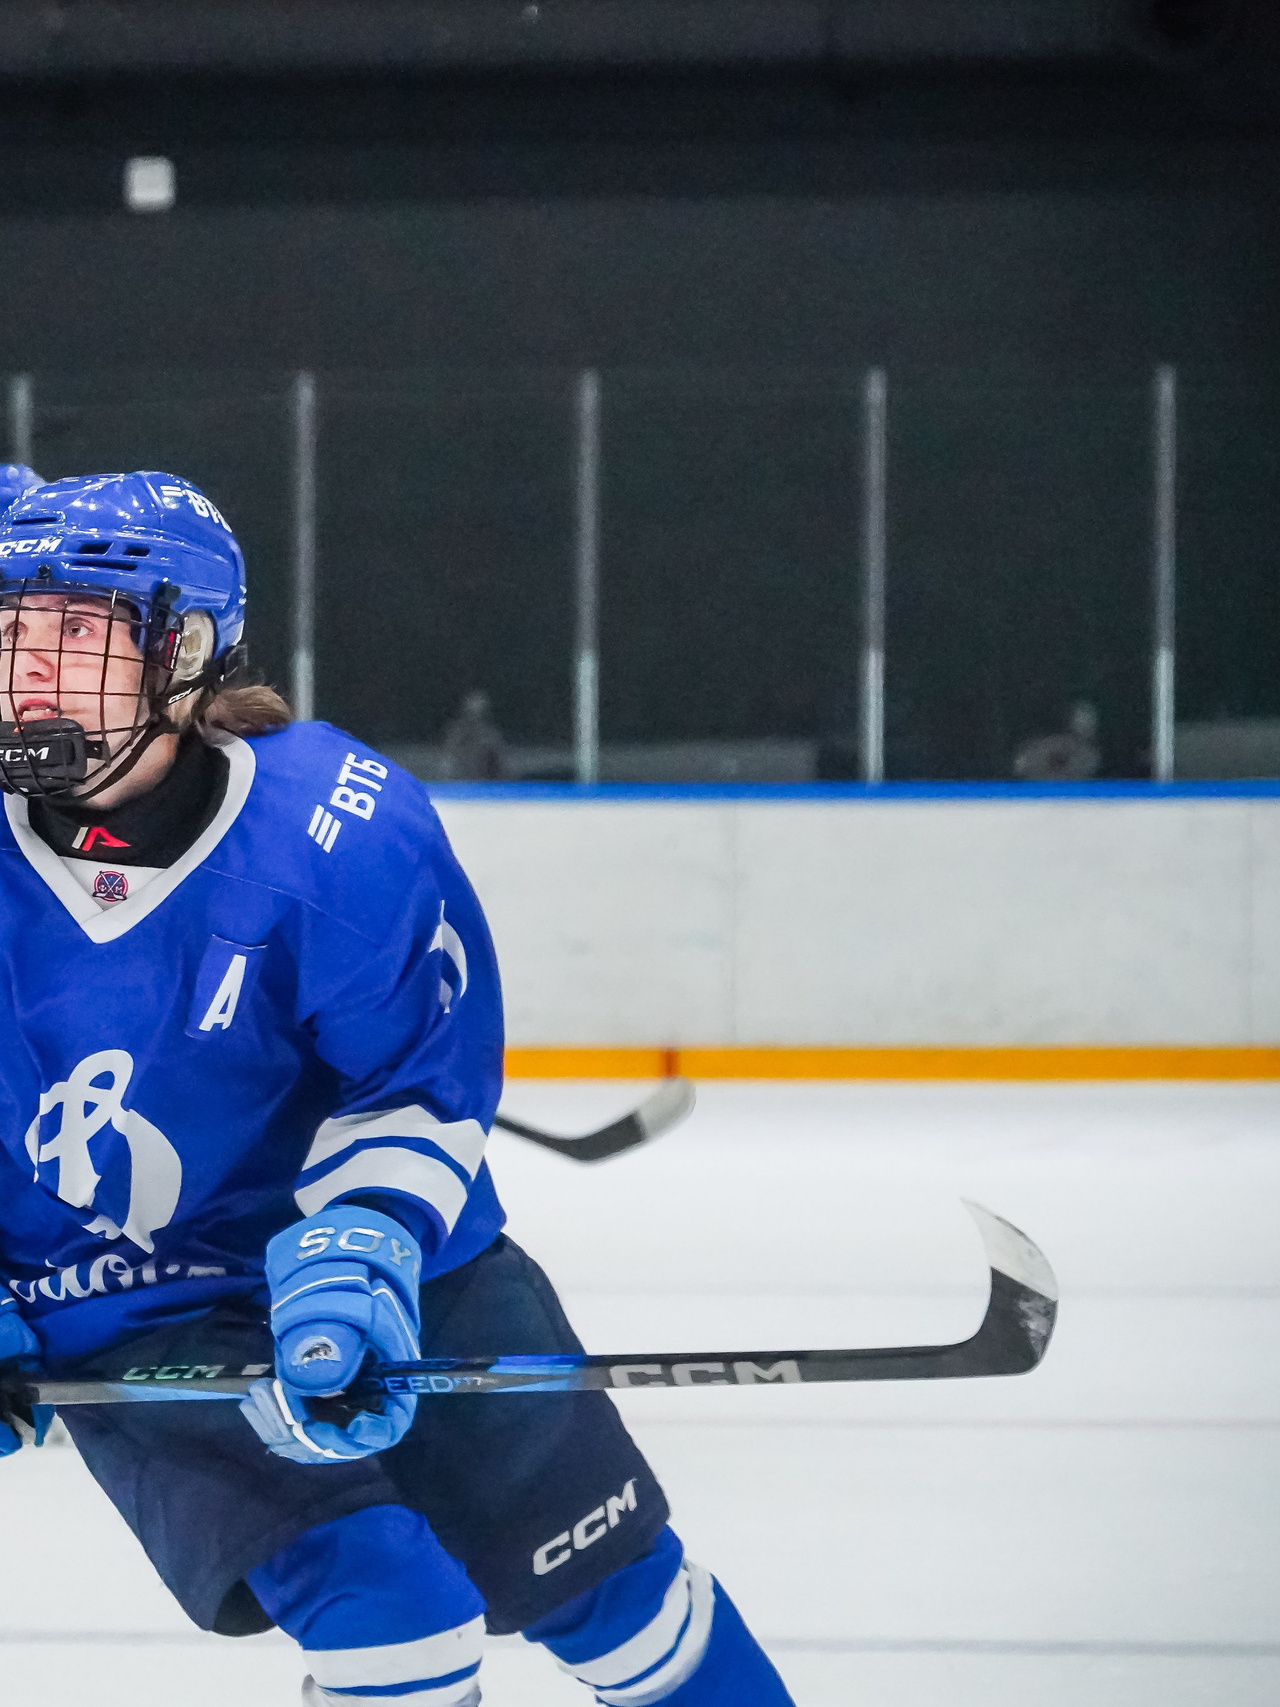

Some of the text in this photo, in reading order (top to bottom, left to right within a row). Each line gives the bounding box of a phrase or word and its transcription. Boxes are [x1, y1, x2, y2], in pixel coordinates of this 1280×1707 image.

[329, 751, 389, 821] ВТБ
[199, 954, 247, 1032] A
[122, 1364, 226, 1381] CCM
[609, 1359, 803, 1388] CCM
[533, 1477, 638, 1576] CCM
